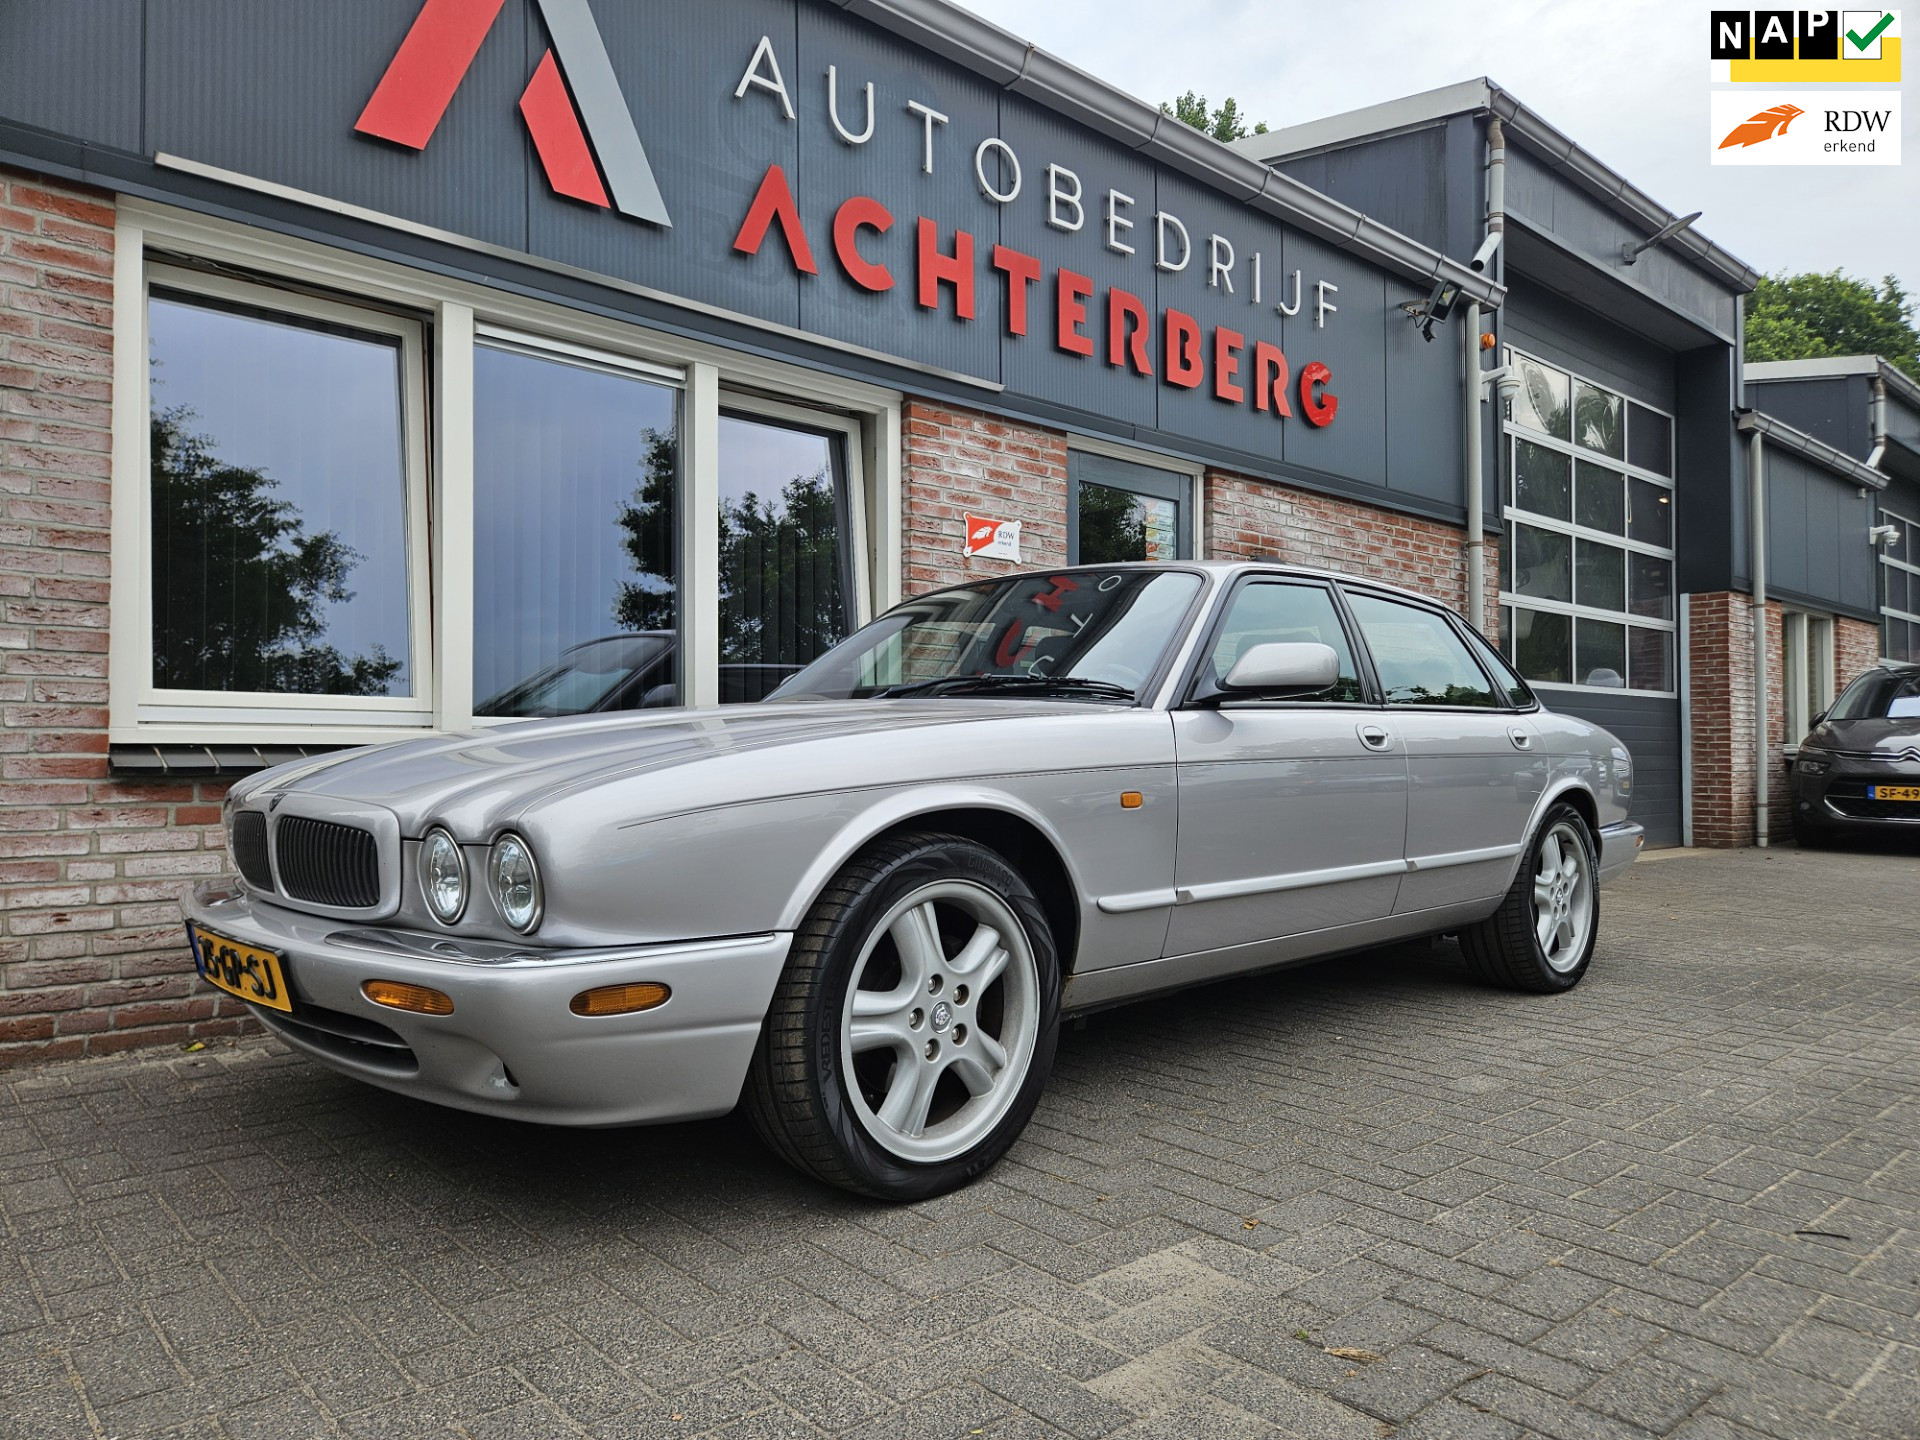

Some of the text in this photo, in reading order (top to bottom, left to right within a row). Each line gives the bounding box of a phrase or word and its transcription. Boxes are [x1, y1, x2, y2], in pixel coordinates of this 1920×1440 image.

[733, 163, 1339, 428] ACHTERBERG
[734, 35, 1339, 328] AUTOBEDRIJF
[998, 530, 1015, 540] RDW
